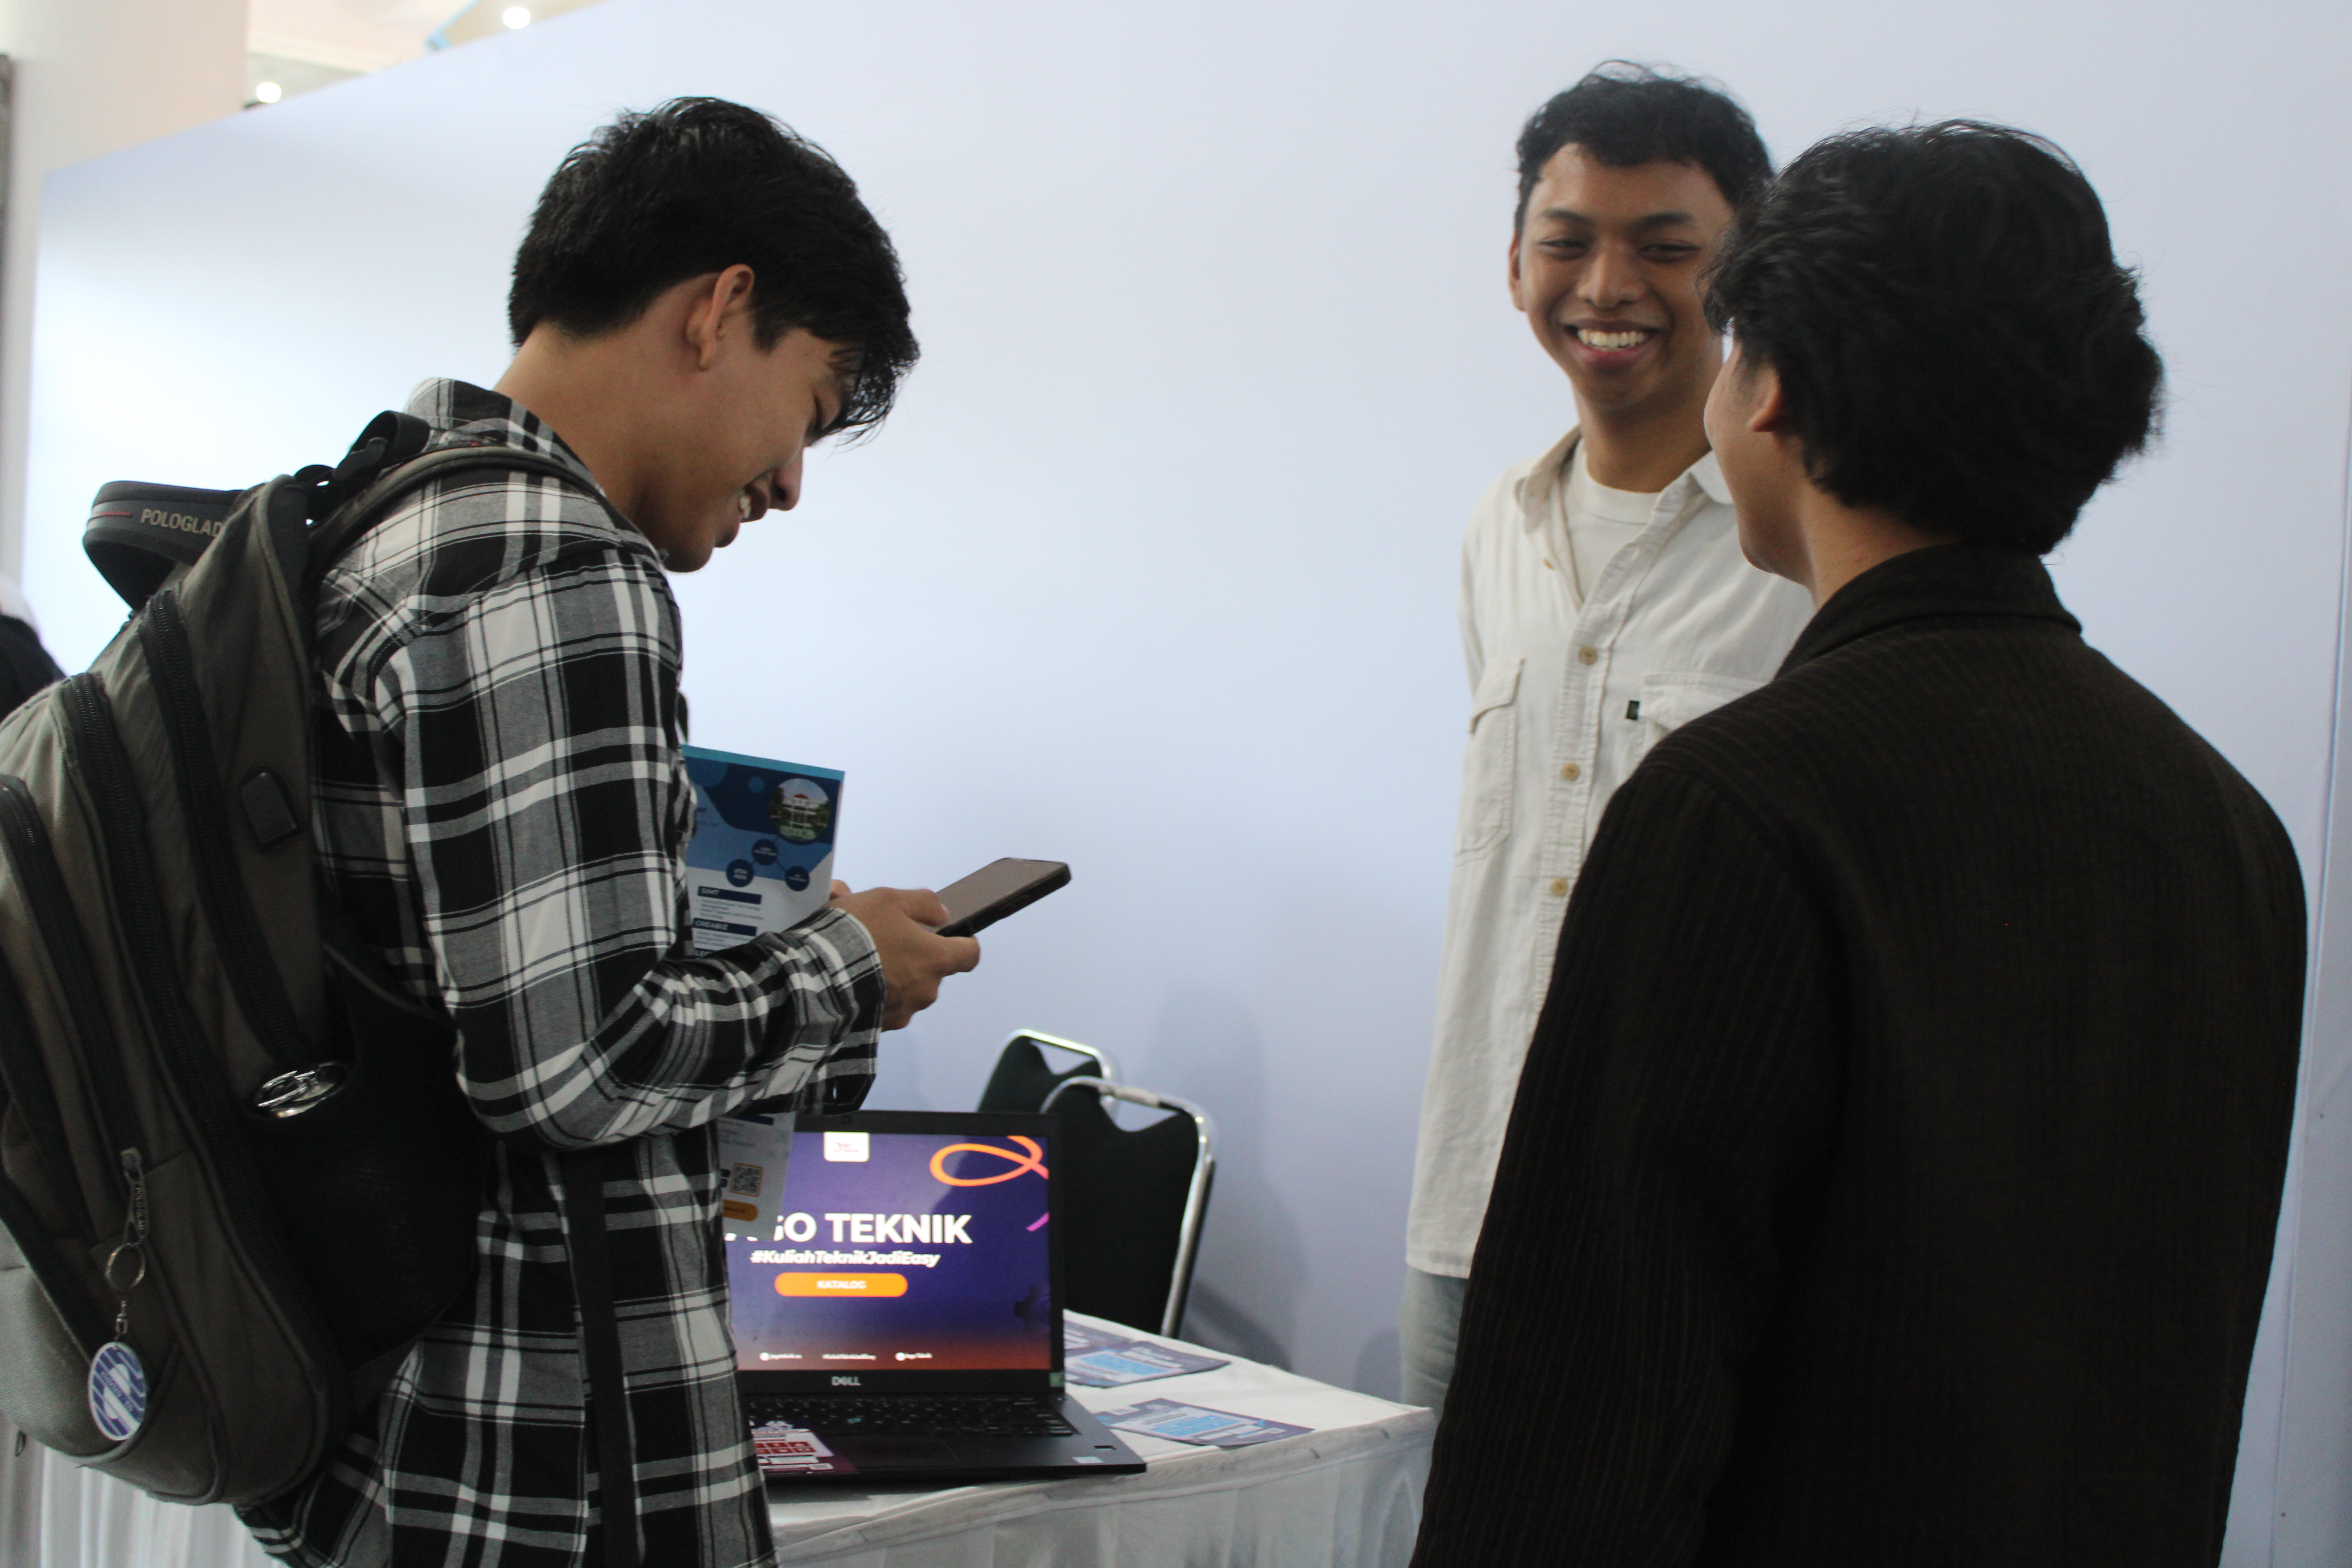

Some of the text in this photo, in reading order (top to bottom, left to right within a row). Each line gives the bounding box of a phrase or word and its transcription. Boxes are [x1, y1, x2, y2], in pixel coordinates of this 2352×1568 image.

[825, 1213, 973, 1243] TEKNIK
[750, 1249, 941, 1268] #KuliahTeknikJadiEasy
[817, 1280, 866, 1289] KATALOG
[831, 1376, 861, 1386] DELL
